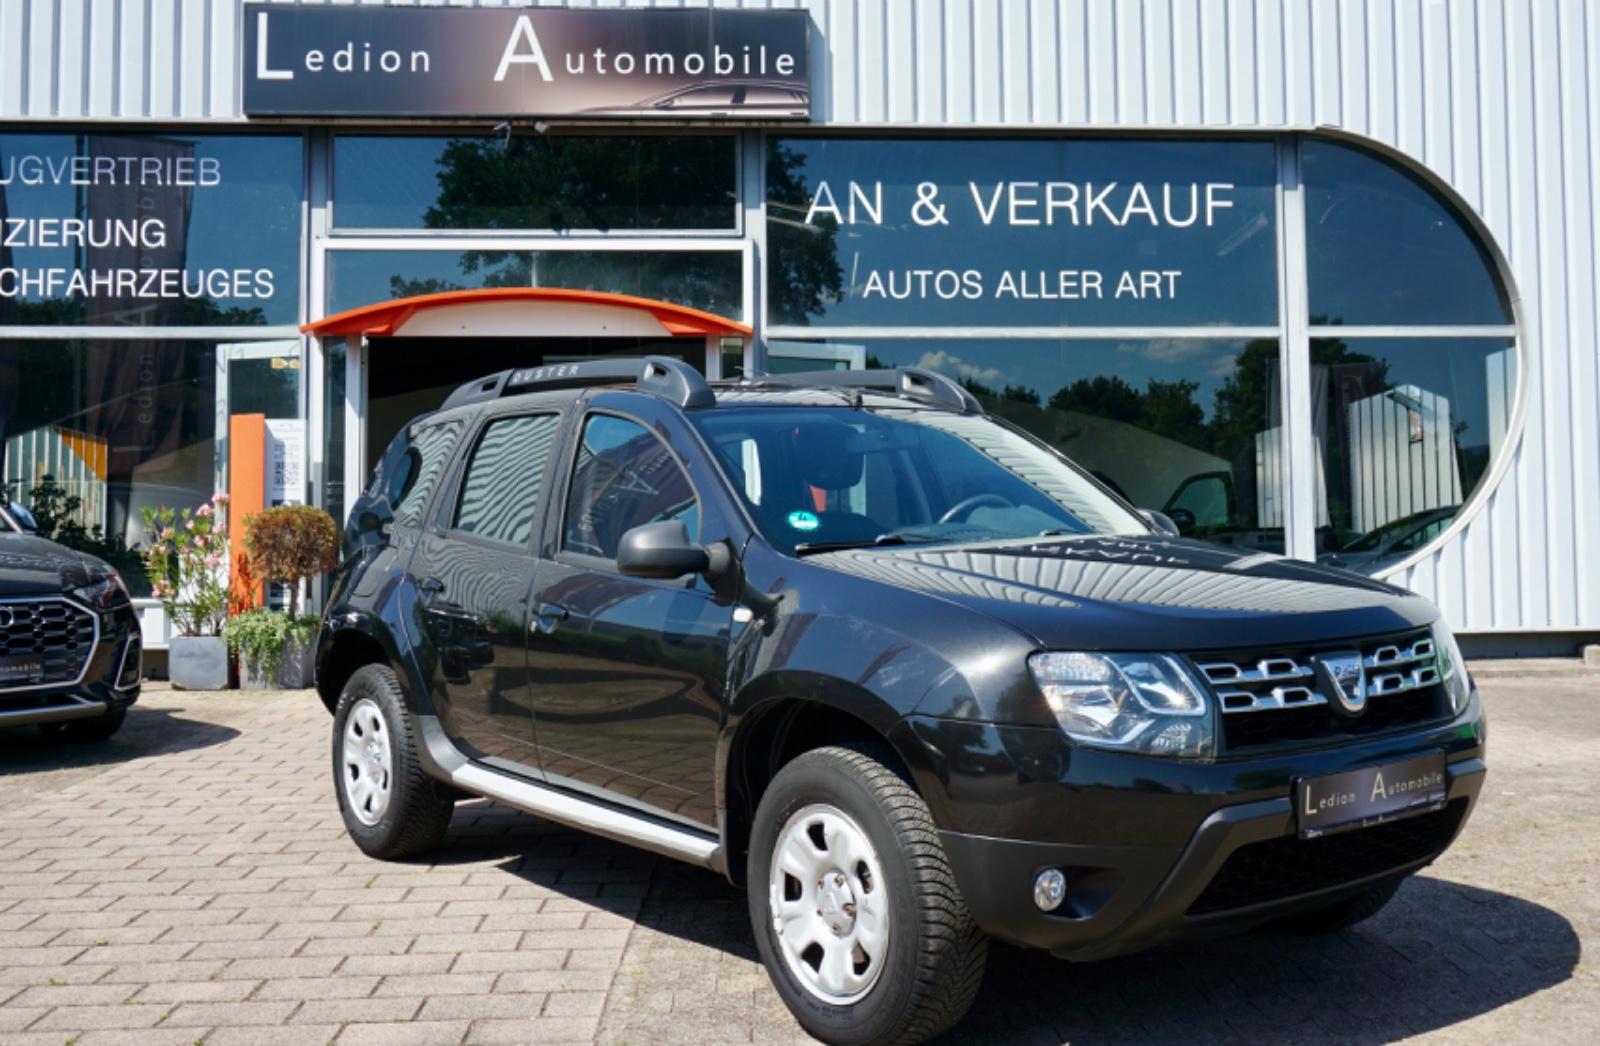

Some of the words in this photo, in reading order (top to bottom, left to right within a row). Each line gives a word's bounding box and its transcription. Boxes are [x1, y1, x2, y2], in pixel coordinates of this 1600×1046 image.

[256, 11, 431, 80] Ledion
[493, 14, 796, 82] Automobile
[804, 181, 883, 225] AN
[910, 181, 950, 226] &
[969, 181, 1235, 227] VERKAUF
[0, 268, 275, 299] CHFAHRZEUGES
[862, 269, 983, 299] AUTOS
[995, 270, 1103, 299] ALLER
[1114, 270, 1182, 299] ART
[511, 365, 579, 383] DUSTER
[1305, 784, 1357, 816] Ledion
